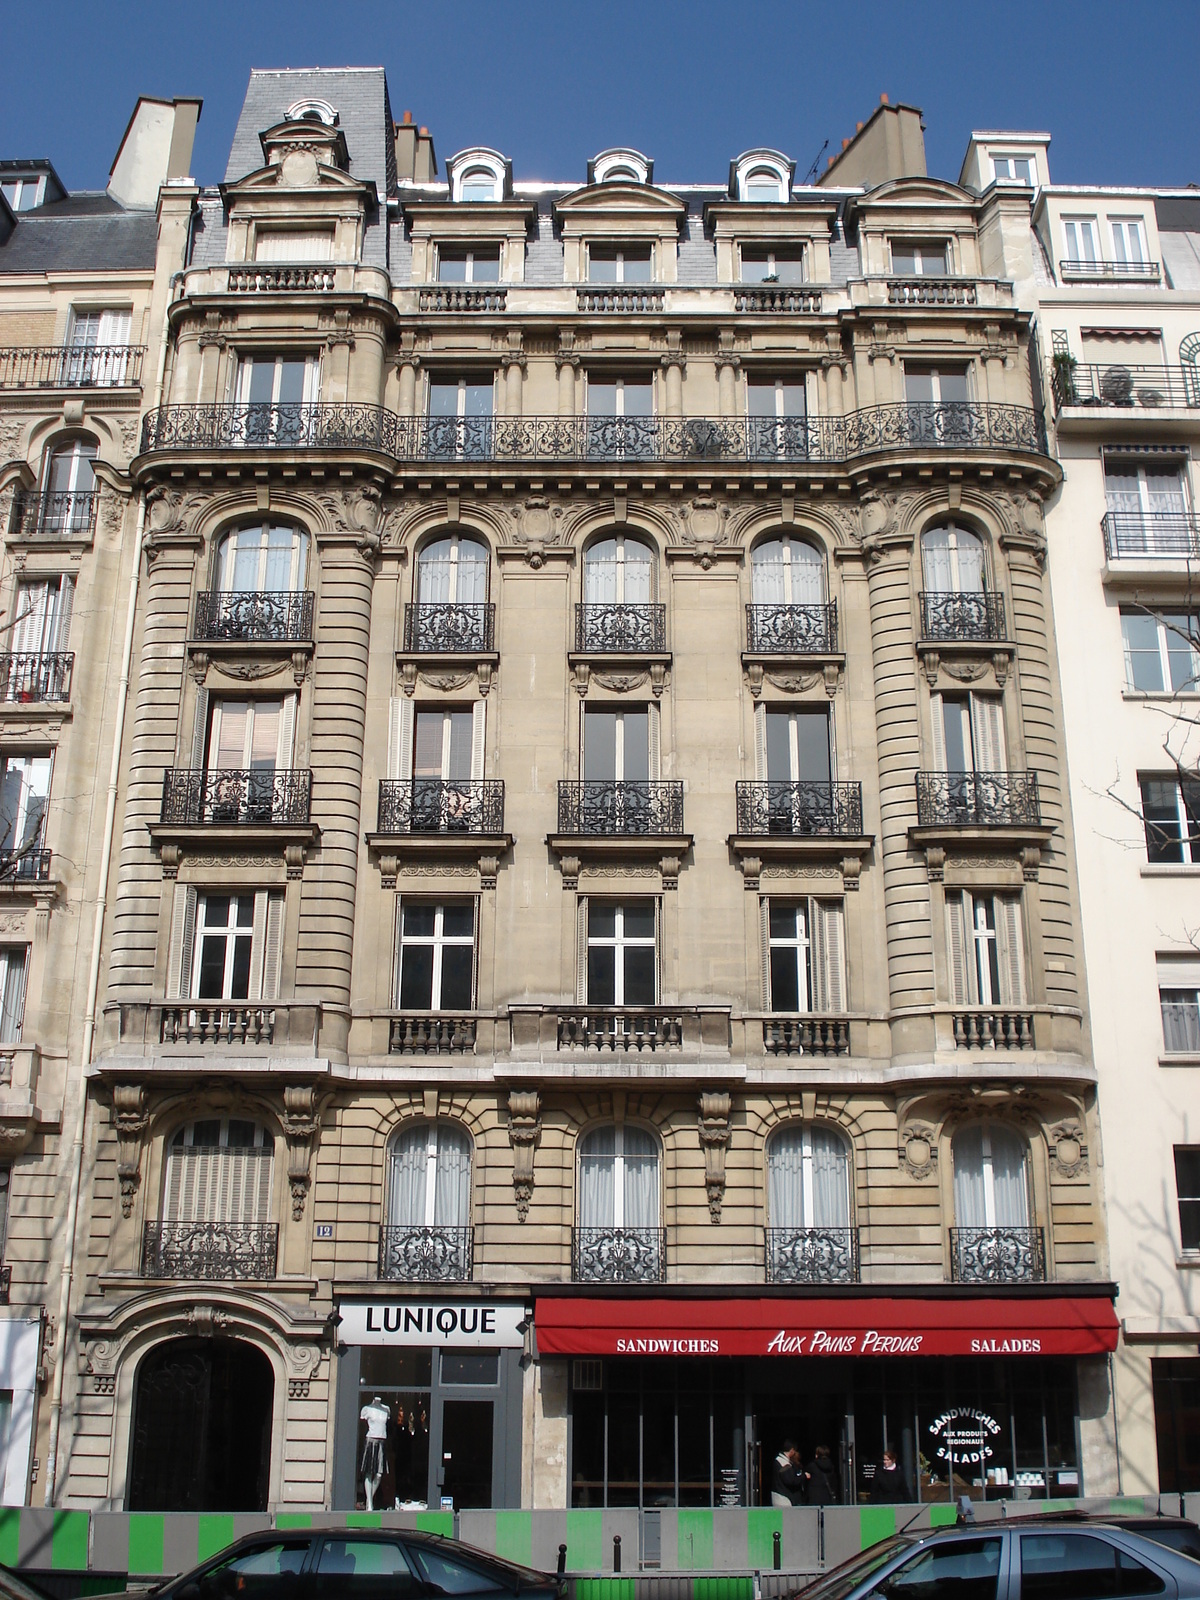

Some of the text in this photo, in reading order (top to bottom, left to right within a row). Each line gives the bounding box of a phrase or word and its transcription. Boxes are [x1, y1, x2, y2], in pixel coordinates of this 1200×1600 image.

[319, 1226, 330, 1236] 12
[366, 1307, 496, 1338] LUNIQUE
[617, 1339, 719, 1353] SANDWICHES
[767, 1330, 923, 1353] AUX PAINS PERDUS
[971, 1339, 1041, 1352] SALADES
[929, 1407, 1001, 1435] SANDWICHES
[936, 1446, 993, 1463] SALADES
